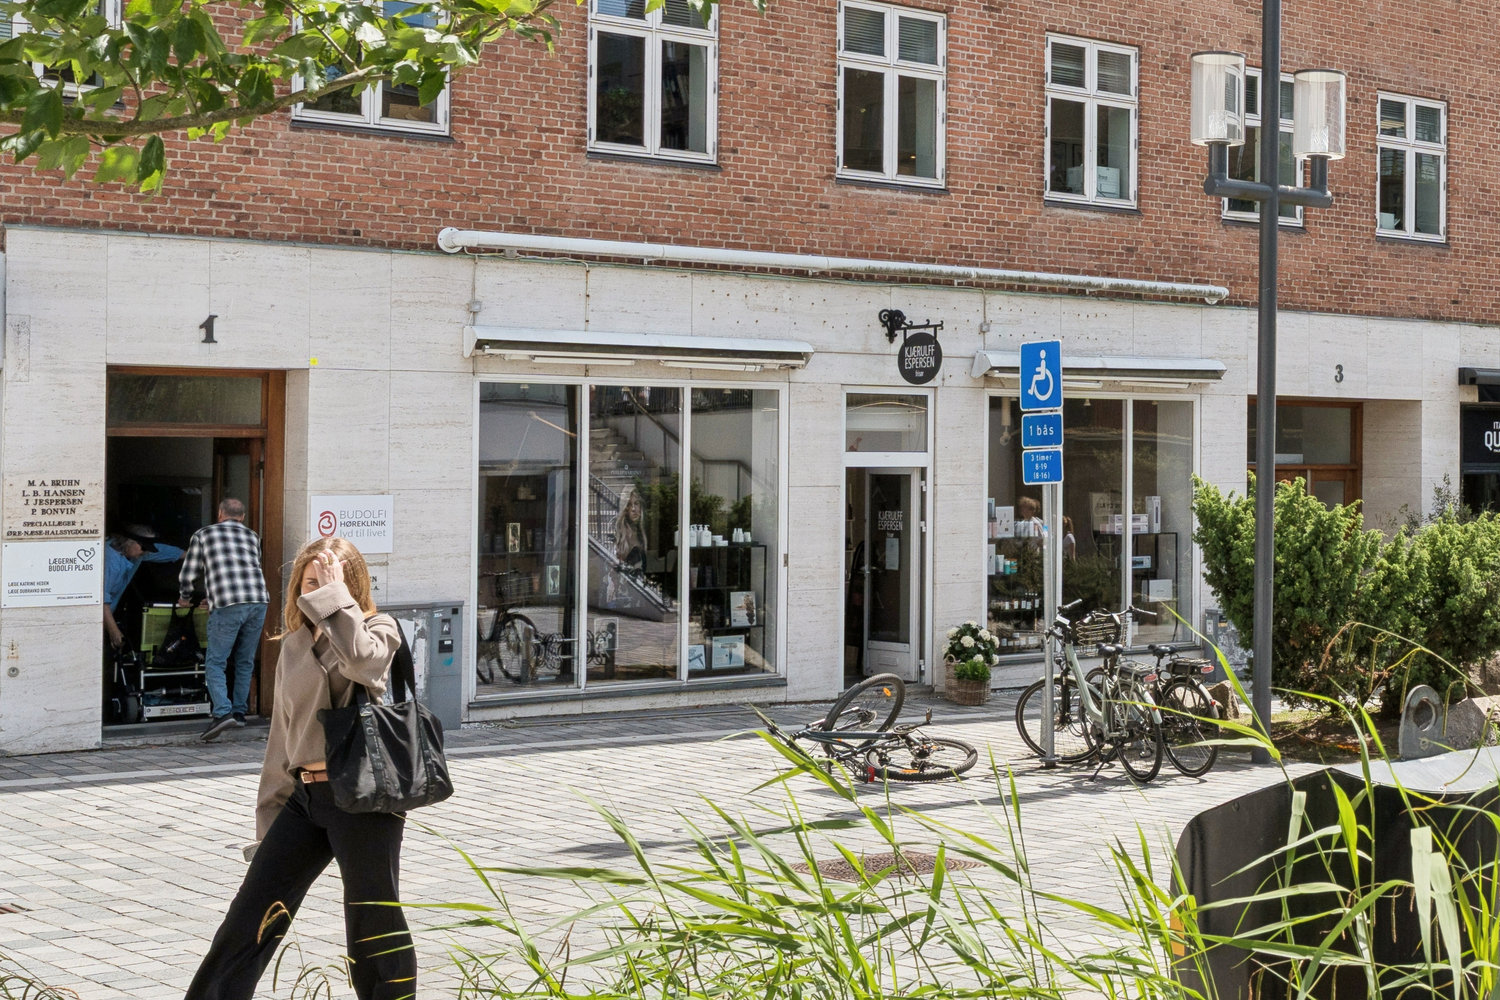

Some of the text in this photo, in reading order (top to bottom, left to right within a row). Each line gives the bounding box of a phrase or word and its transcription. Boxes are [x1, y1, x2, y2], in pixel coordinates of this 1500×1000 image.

[199, 314, 218, 344] 1
[904, 345, 935, 358] KJÆRULFF
[904, 356, 935, 370] ESPERSEN
[1334, 364, 1344, 383] 3
[1029, 424, 1054, 436] 1 bås
[1031, 454, 1034, 462] 3
[51, 479, 80, 487] BRUHN
[43, 489, 85, 497] HANSEN
[33, 498, 83, 506] JESPERSEN
[41, 507, 76, 515] BONVIN
[340, 510, 387, 520] BUDOLFI
[340, 520, 386, 528] HØREKLINIK
[340, 529, 386, 538] lyd til livet
[48, 557, 77, 565] LÆGERNE
[74, 564, 93, 572] PLADS
